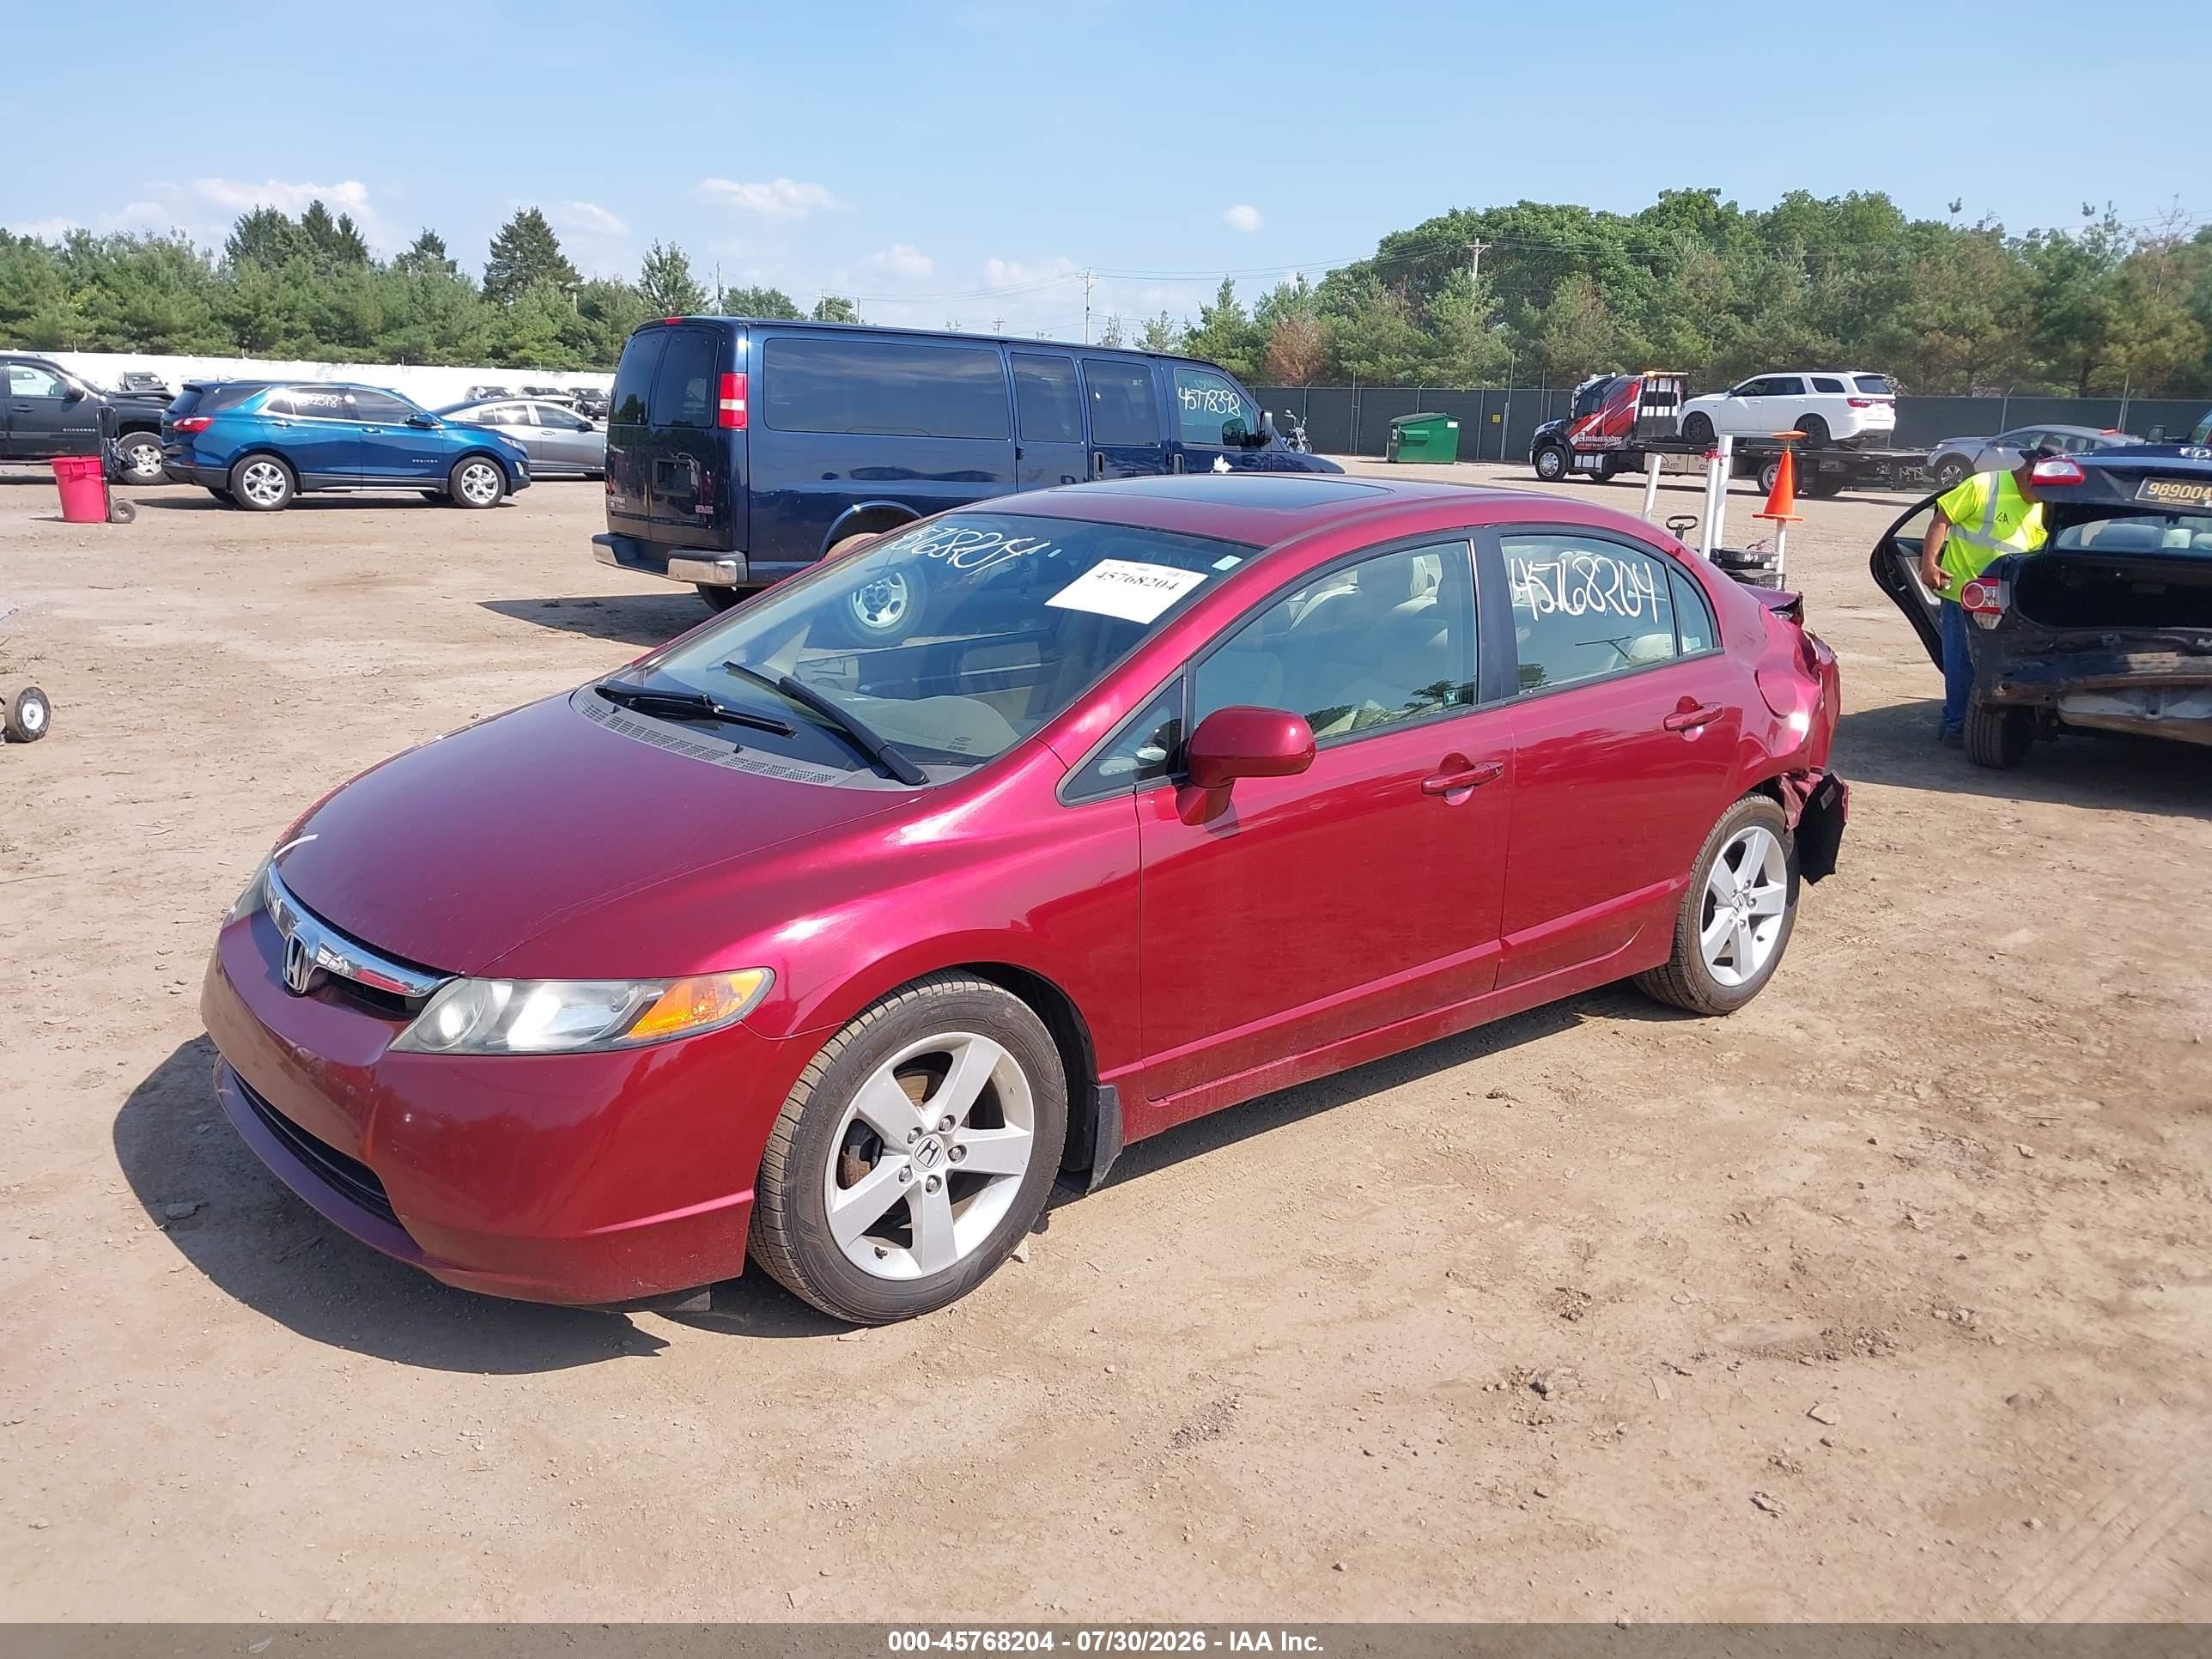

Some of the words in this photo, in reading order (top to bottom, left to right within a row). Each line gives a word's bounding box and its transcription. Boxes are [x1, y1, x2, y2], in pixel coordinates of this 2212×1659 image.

[1178, 386, 1241, 417] 45778398
[2147, 482, 2212, 501] 989004
[1095, 571, 1180, 592] 45768204
[1510, 557, 1658, 625] 45768204
